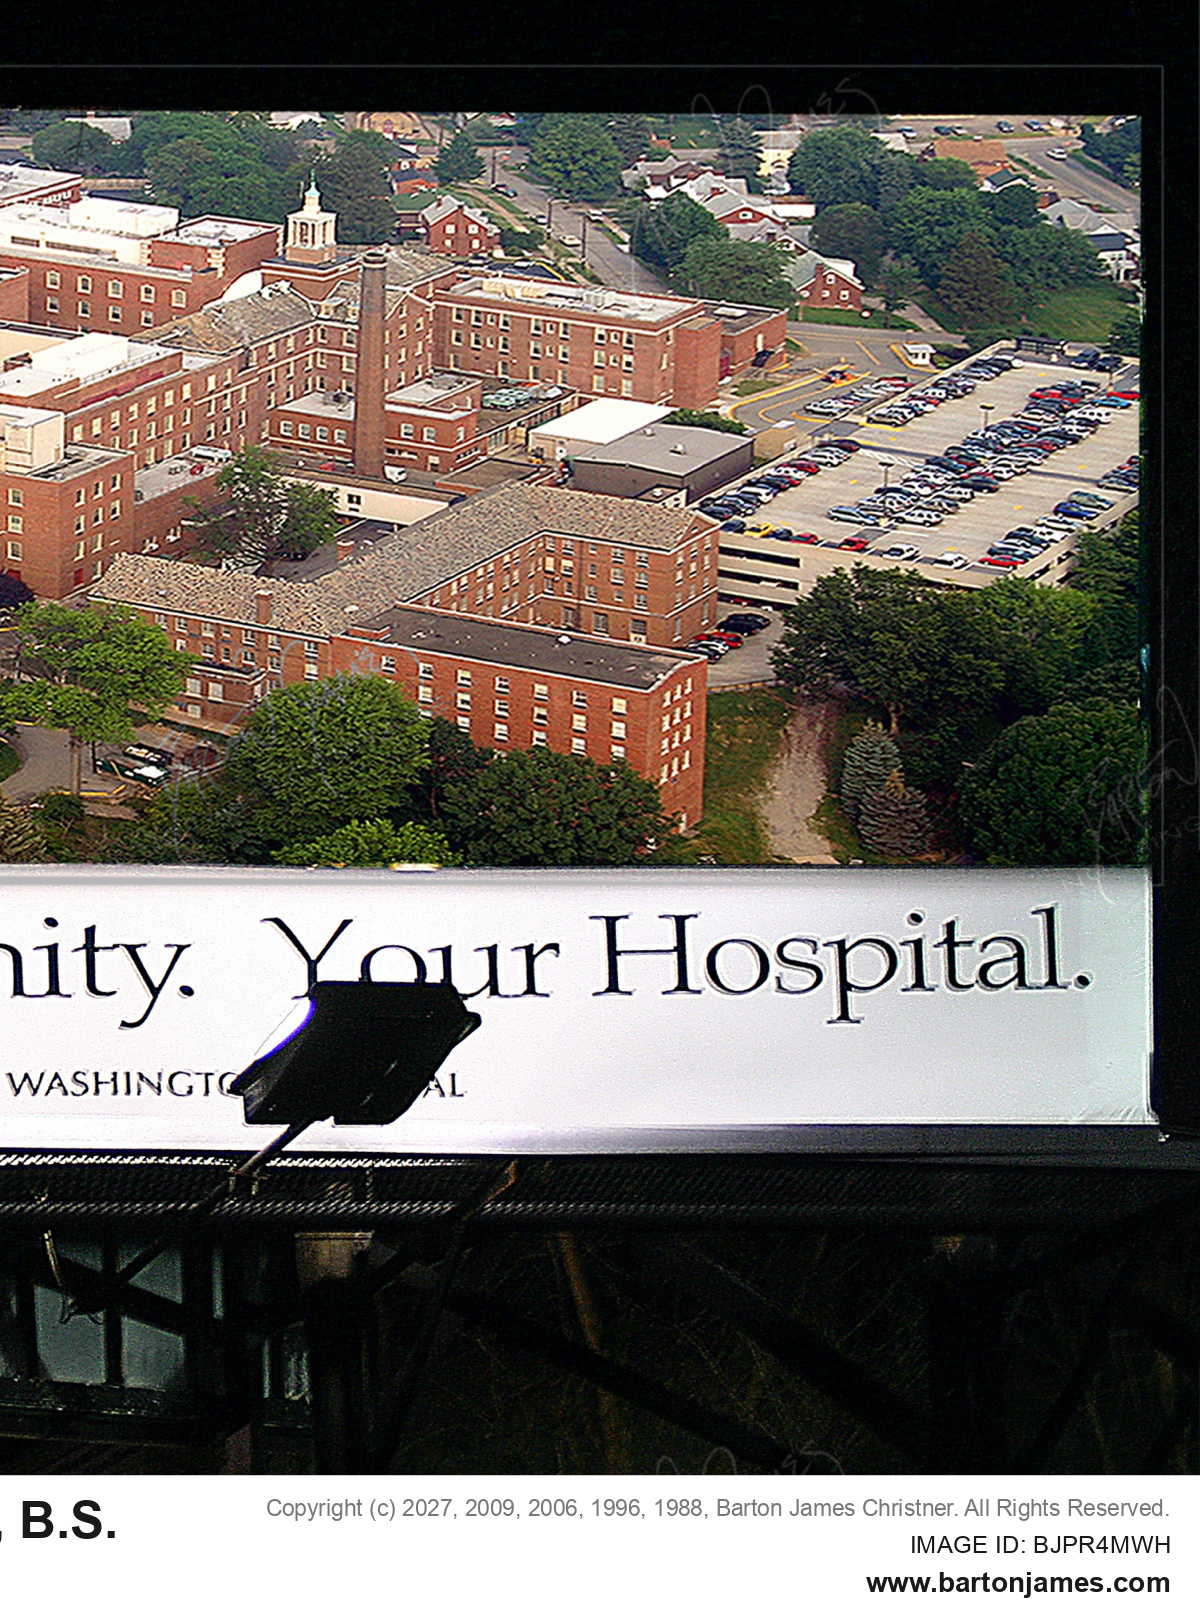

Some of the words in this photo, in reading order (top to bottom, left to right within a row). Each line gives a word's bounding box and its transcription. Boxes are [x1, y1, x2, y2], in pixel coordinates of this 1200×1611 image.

[260, 916, 560, 1000] Your
[589, 907, 1092, 1025] Hospital.
[6, 1071, 242, 1099] WASHINGTO
